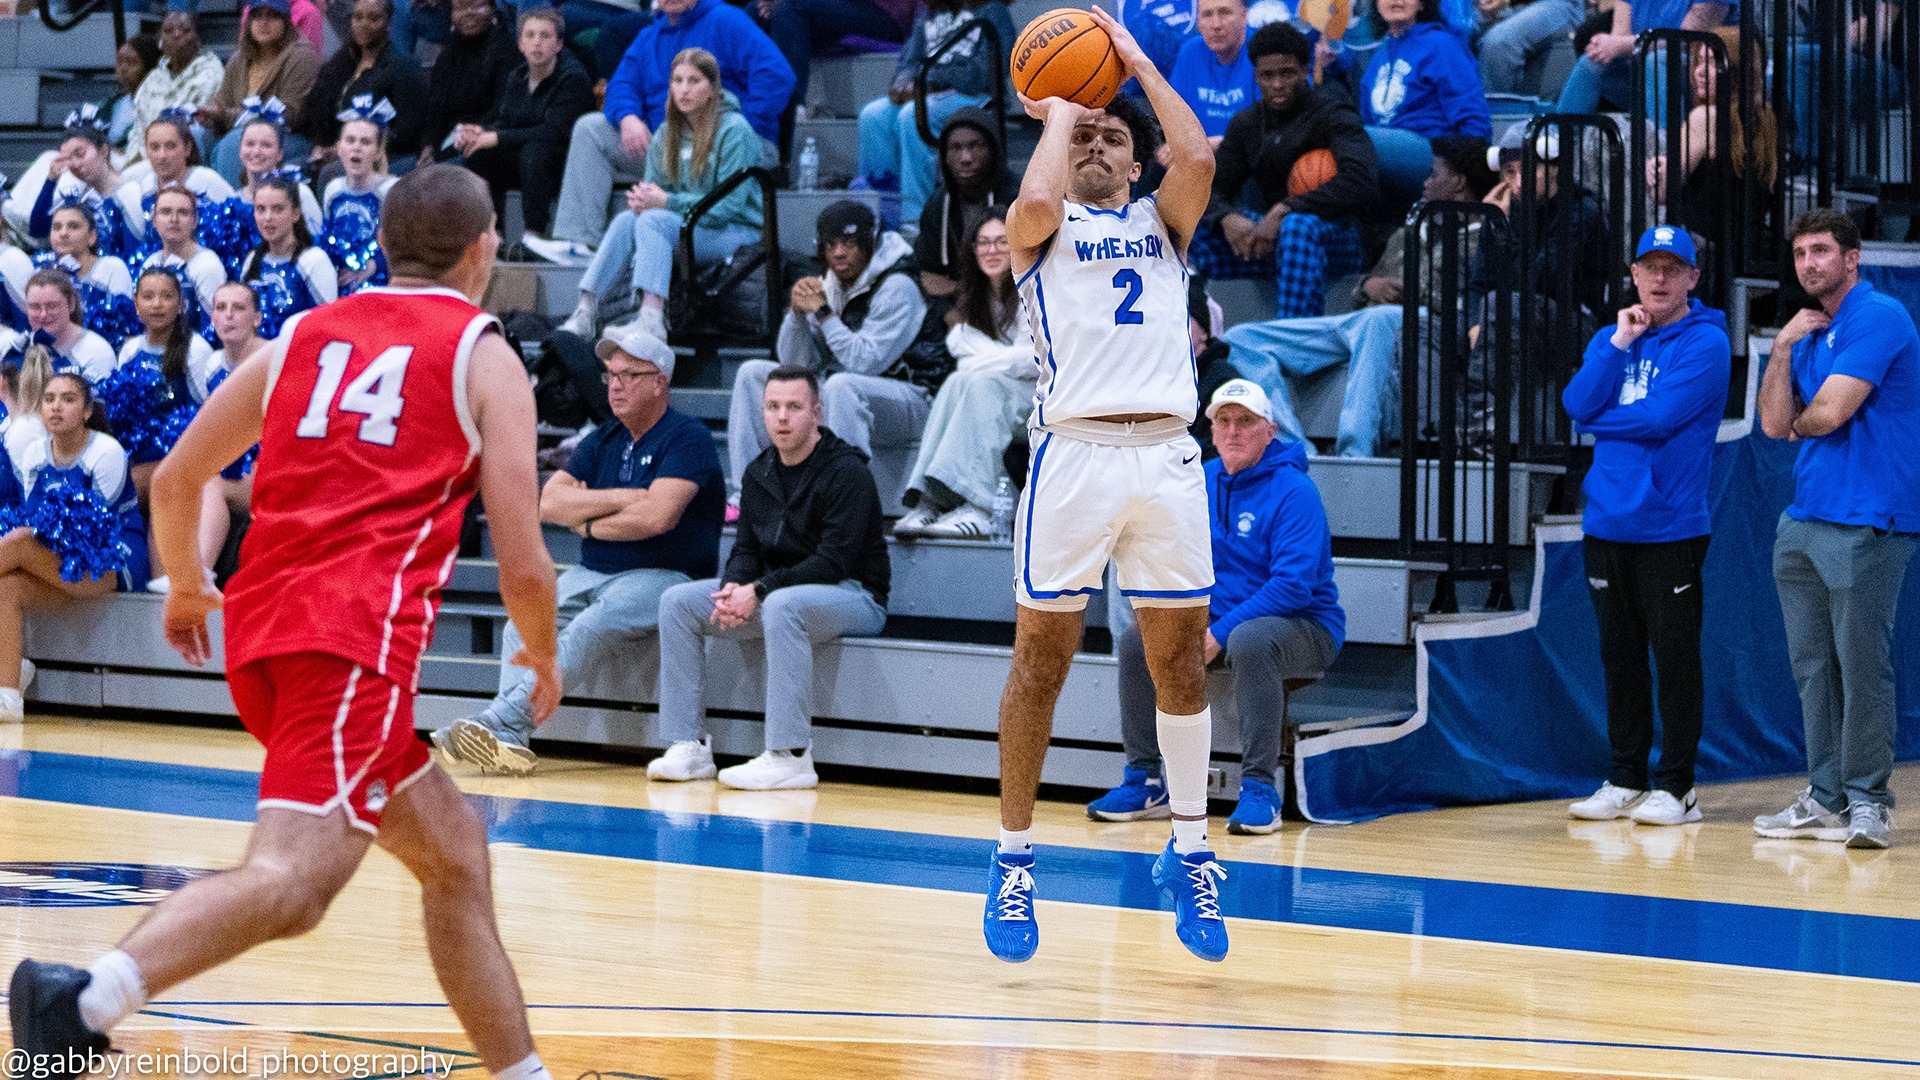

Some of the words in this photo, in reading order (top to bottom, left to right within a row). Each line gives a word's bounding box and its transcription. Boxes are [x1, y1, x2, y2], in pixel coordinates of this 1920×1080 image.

[1016, 18, 1077, 72] Wilson
[1074, 234, 1163, 262] WHEATON
[1112, 268, 1144, 326] 2
[296, 339, 415, 447] 14
